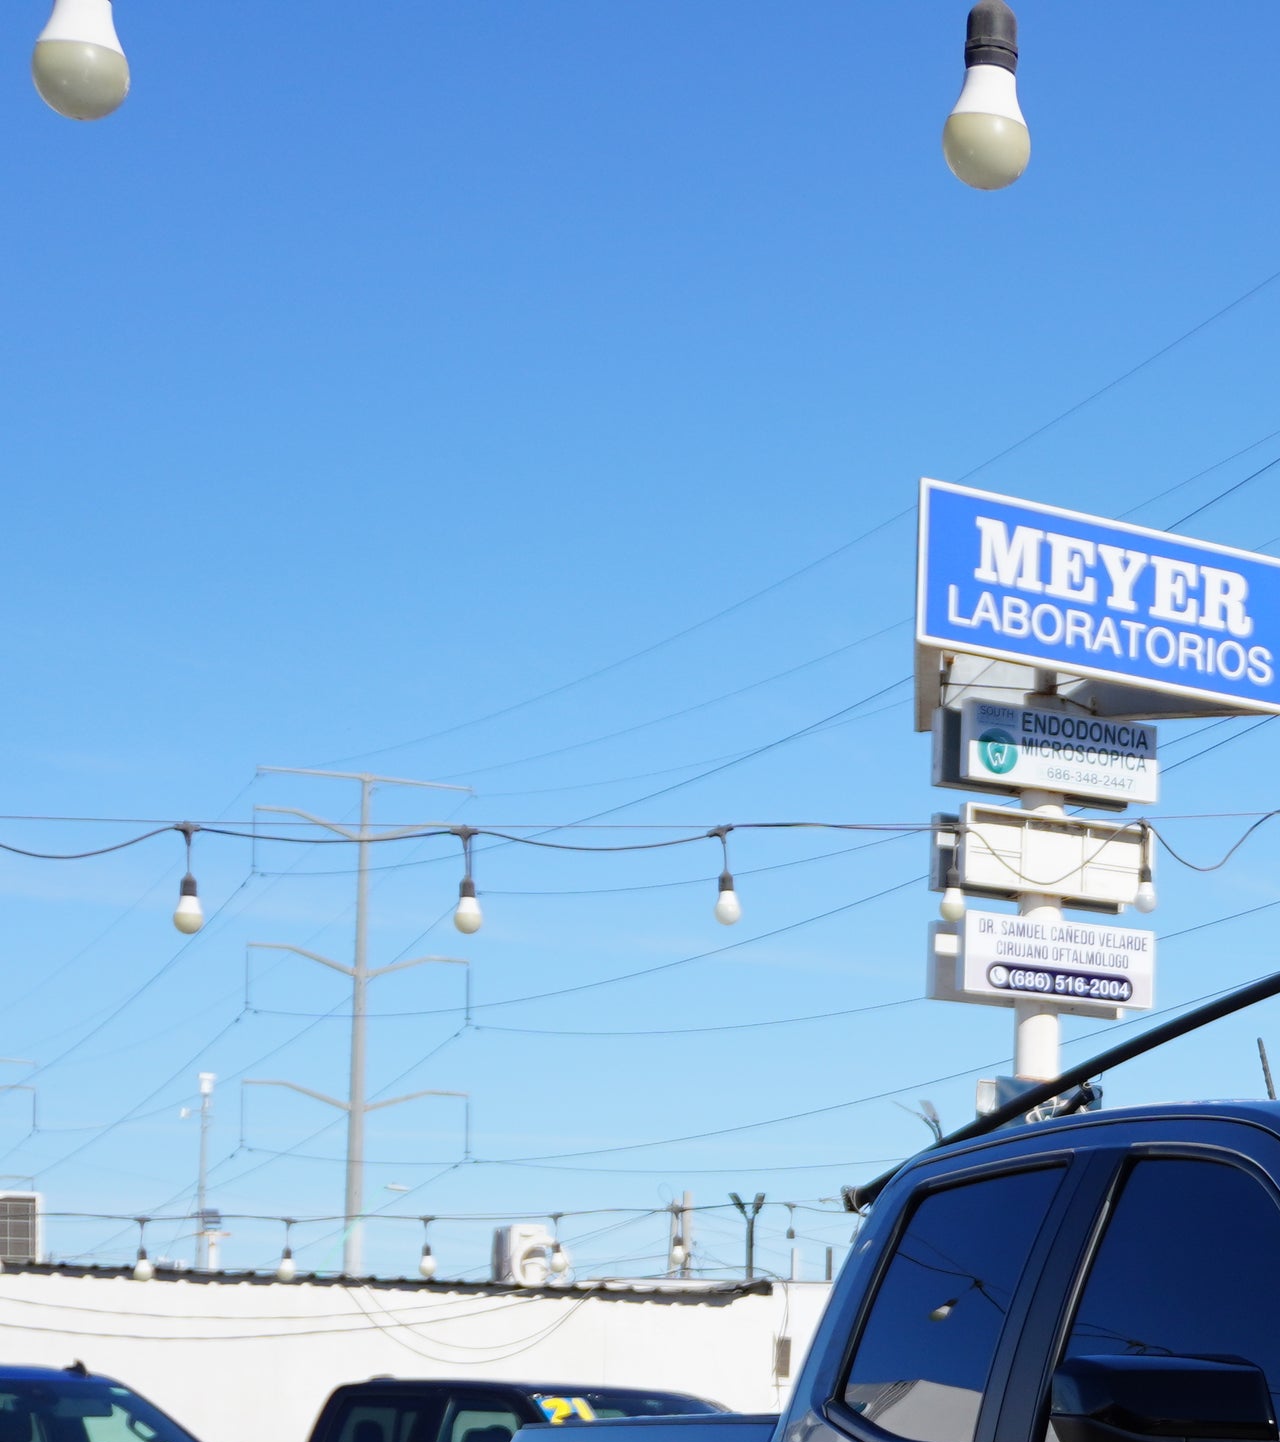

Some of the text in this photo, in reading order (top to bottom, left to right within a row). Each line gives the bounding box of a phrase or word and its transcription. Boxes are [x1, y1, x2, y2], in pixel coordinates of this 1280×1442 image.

[974, 515, 1253, 639] MEYER
[948, 584, 1275, 686] LABORATORIOS
[980, 705, 1014, 720] SOUTH
[1021, 711, 1149, 750] ENDODONCIA
[1021, 737, 1148, 773] MICROSCOPICA
[1046, 767, 1134, 790] 686-348-2447
[978, 918, 1148, 952] DR. SAMUEL CAÑEDO VELARDE
[996, 940, 1129, 969] CIRUJANO OFTALMOLOGO
[1008, 970, 1130, 998] (686) 516-2004
